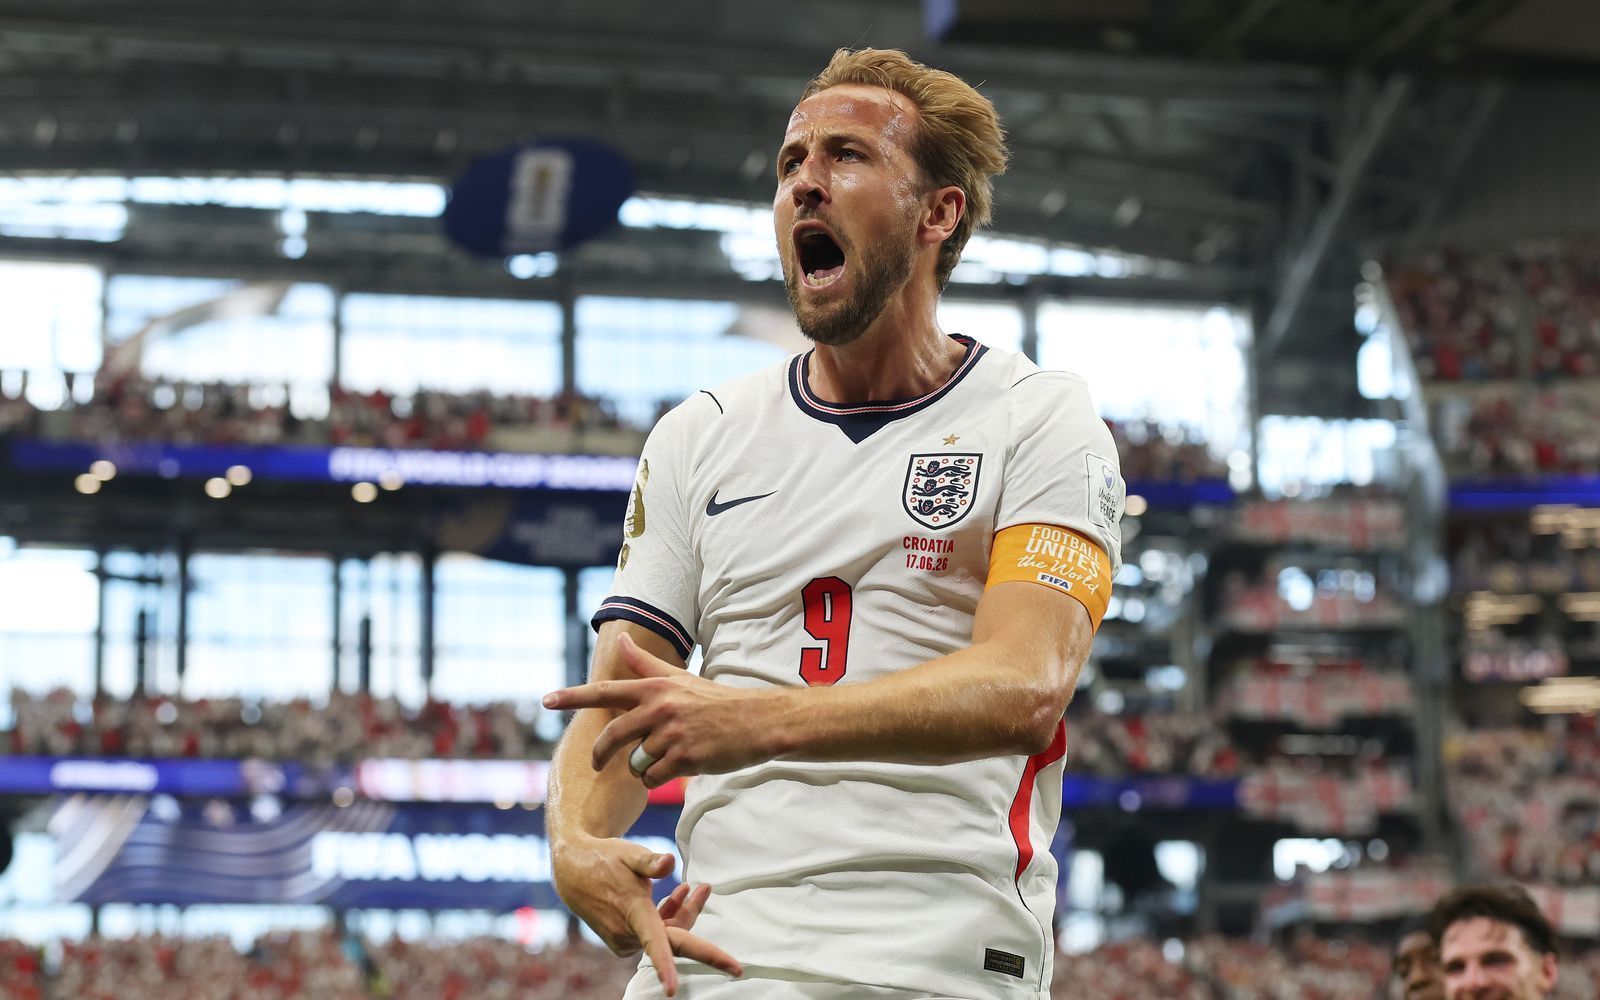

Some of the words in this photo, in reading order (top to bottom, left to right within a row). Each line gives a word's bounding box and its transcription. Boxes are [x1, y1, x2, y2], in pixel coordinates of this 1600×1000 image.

[903, 536, 954, 553] CROATIA
[906, 554, 948, 571] 17.06.26
[1025, 537, 1101, 579] UNITES
[1031, 526, 1100, 564] FOOTBALL
[1017, 554, 1048, 568] the
[1050, 559, 1099, 595] World
[1040, 574, 1069, 590] FIFA
[799, 576, 852, 686] 9
[311, 832, 414, 880] FIFA
[415, 833, 552, 881] WORL
